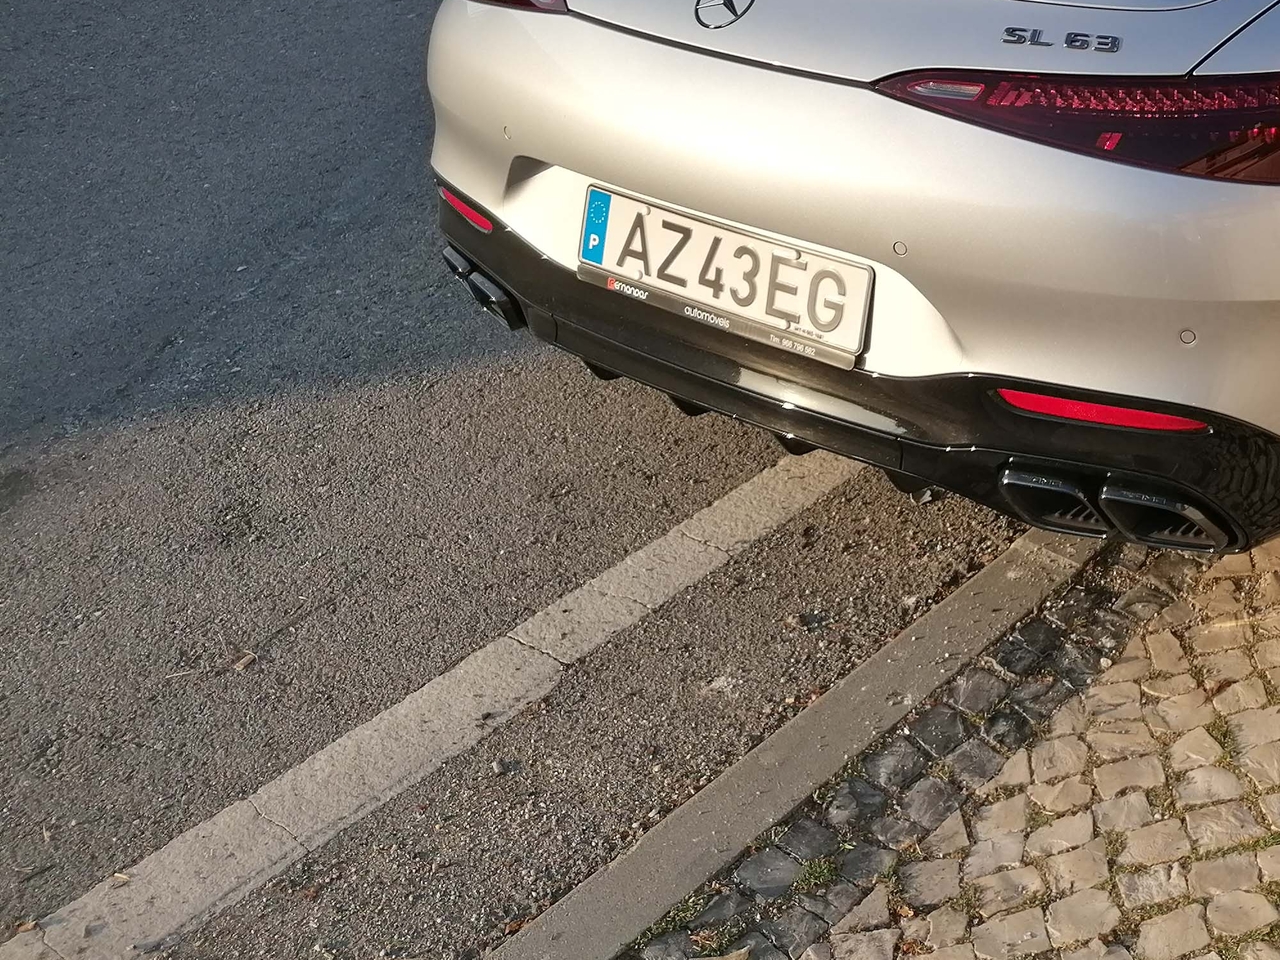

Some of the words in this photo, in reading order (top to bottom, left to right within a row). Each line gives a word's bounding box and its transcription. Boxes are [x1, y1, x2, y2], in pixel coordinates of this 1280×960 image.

[1000, 26, 1054, 47] SL
[1062, 31, 1123, 53] 63
[588, 233, 600, 250] P
[616, 211, 847, 333] AZ43EG
[684, 305, 730, 329] automóveis
